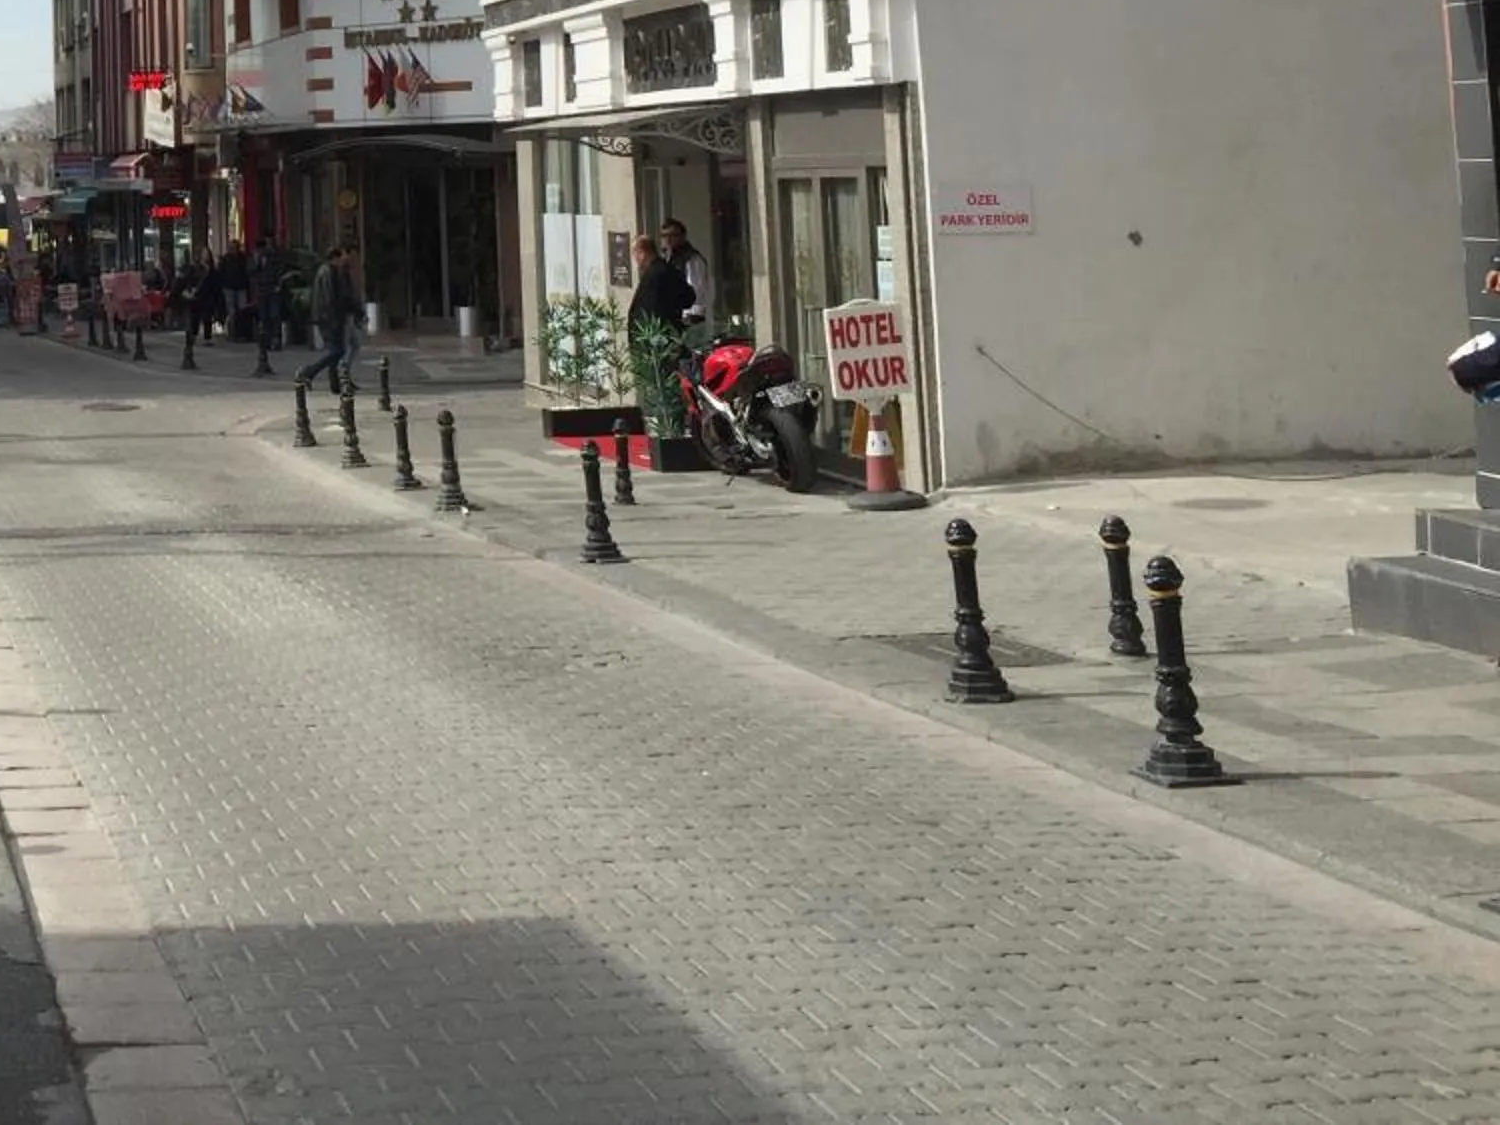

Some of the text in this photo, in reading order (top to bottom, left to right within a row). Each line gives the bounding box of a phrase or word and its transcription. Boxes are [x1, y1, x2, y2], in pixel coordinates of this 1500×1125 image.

[966, 191, 1001, 206] ÖZEL
[940, 211, 1029, 226] PARK YERİDİR
[828, 312, 902, 350] HOTEL
[837, 356, 908, 391] OKUR
